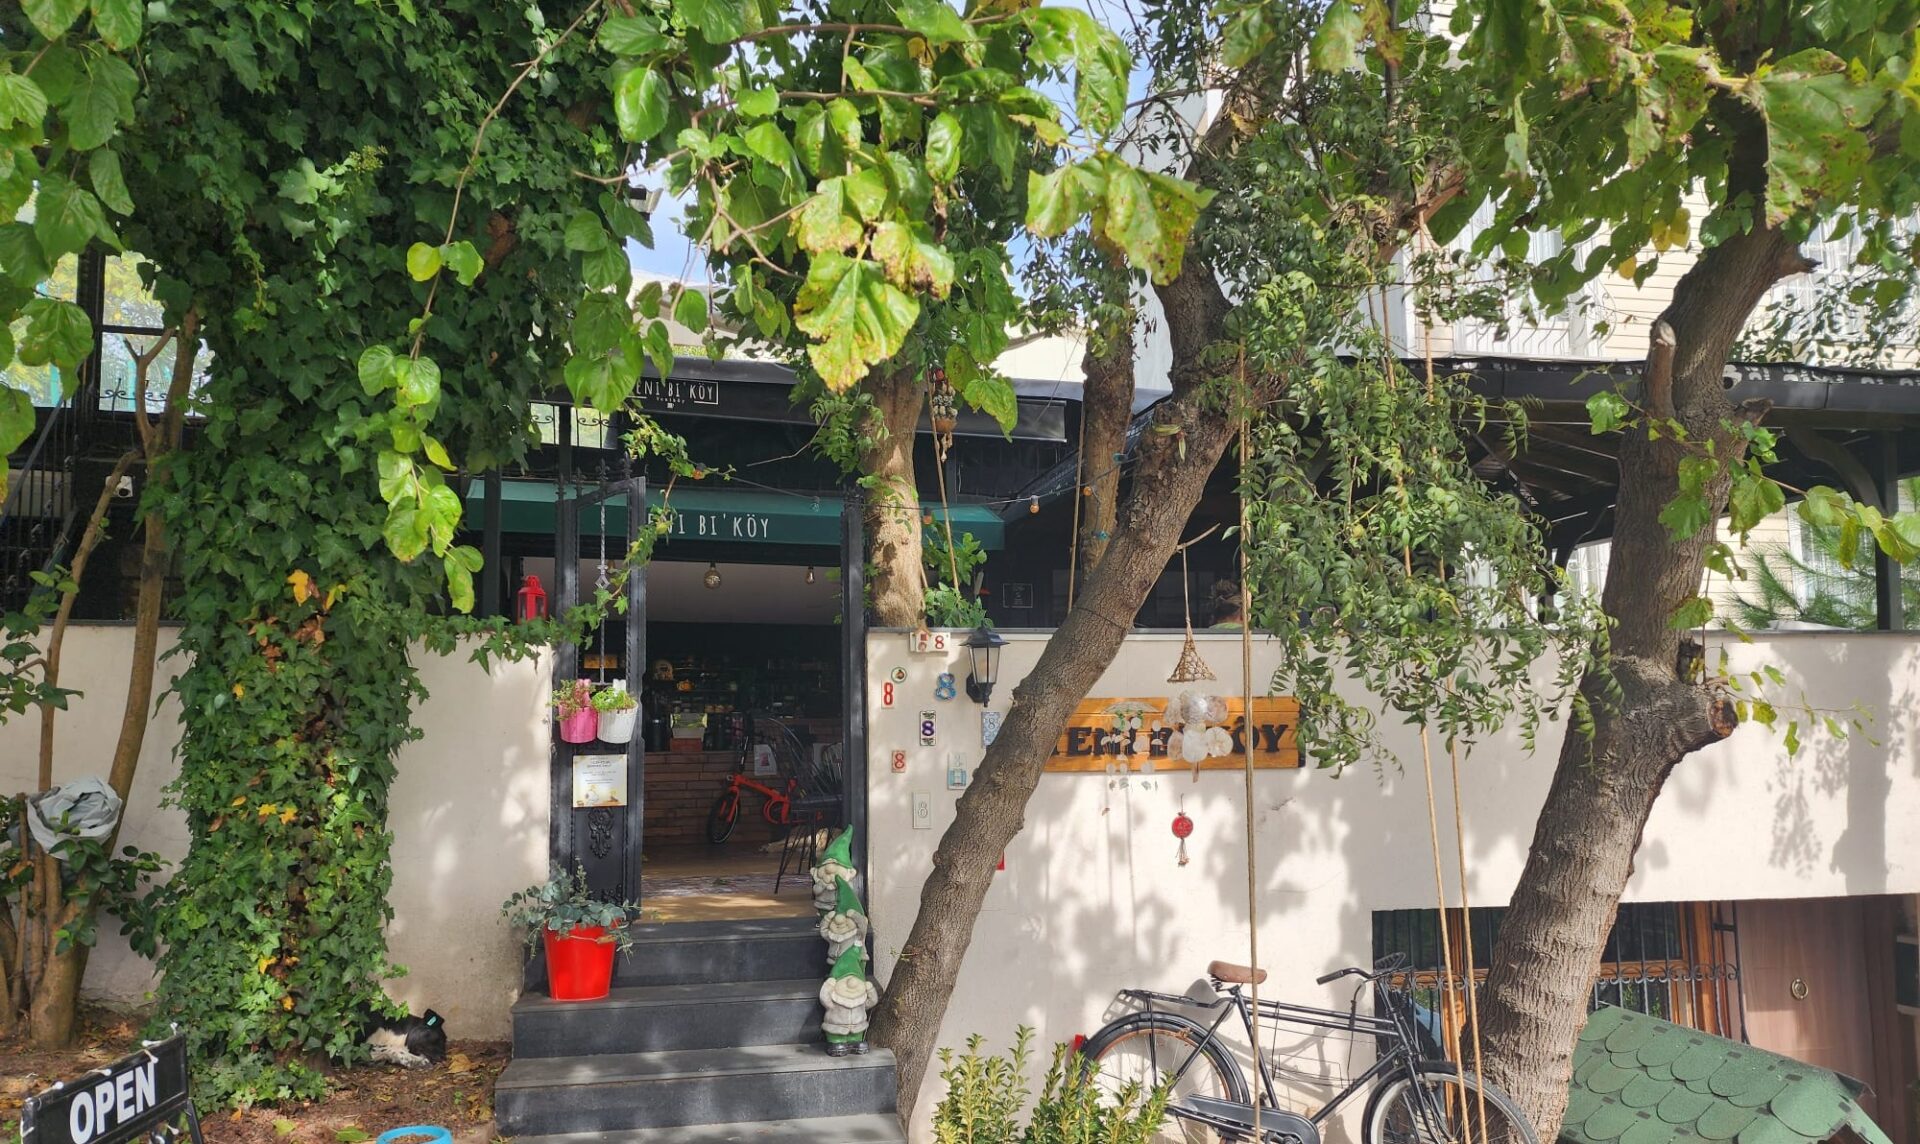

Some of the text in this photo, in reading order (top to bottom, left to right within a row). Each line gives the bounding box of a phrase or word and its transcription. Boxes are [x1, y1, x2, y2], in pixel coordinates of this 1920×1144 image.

[636, 380, 660, 396] ENI
[934, 634, 945, 650] 8
[883, 682, 894, 706] 8
[935, 673, 956, 700] 8
[922, 720, 935, 736] 8
[987, 718, 996, 730] 8
[894, 752, 905, 769] 8
[917, 801, 928, 819] 8
[69, 1061, 157, 1144] OPEN
